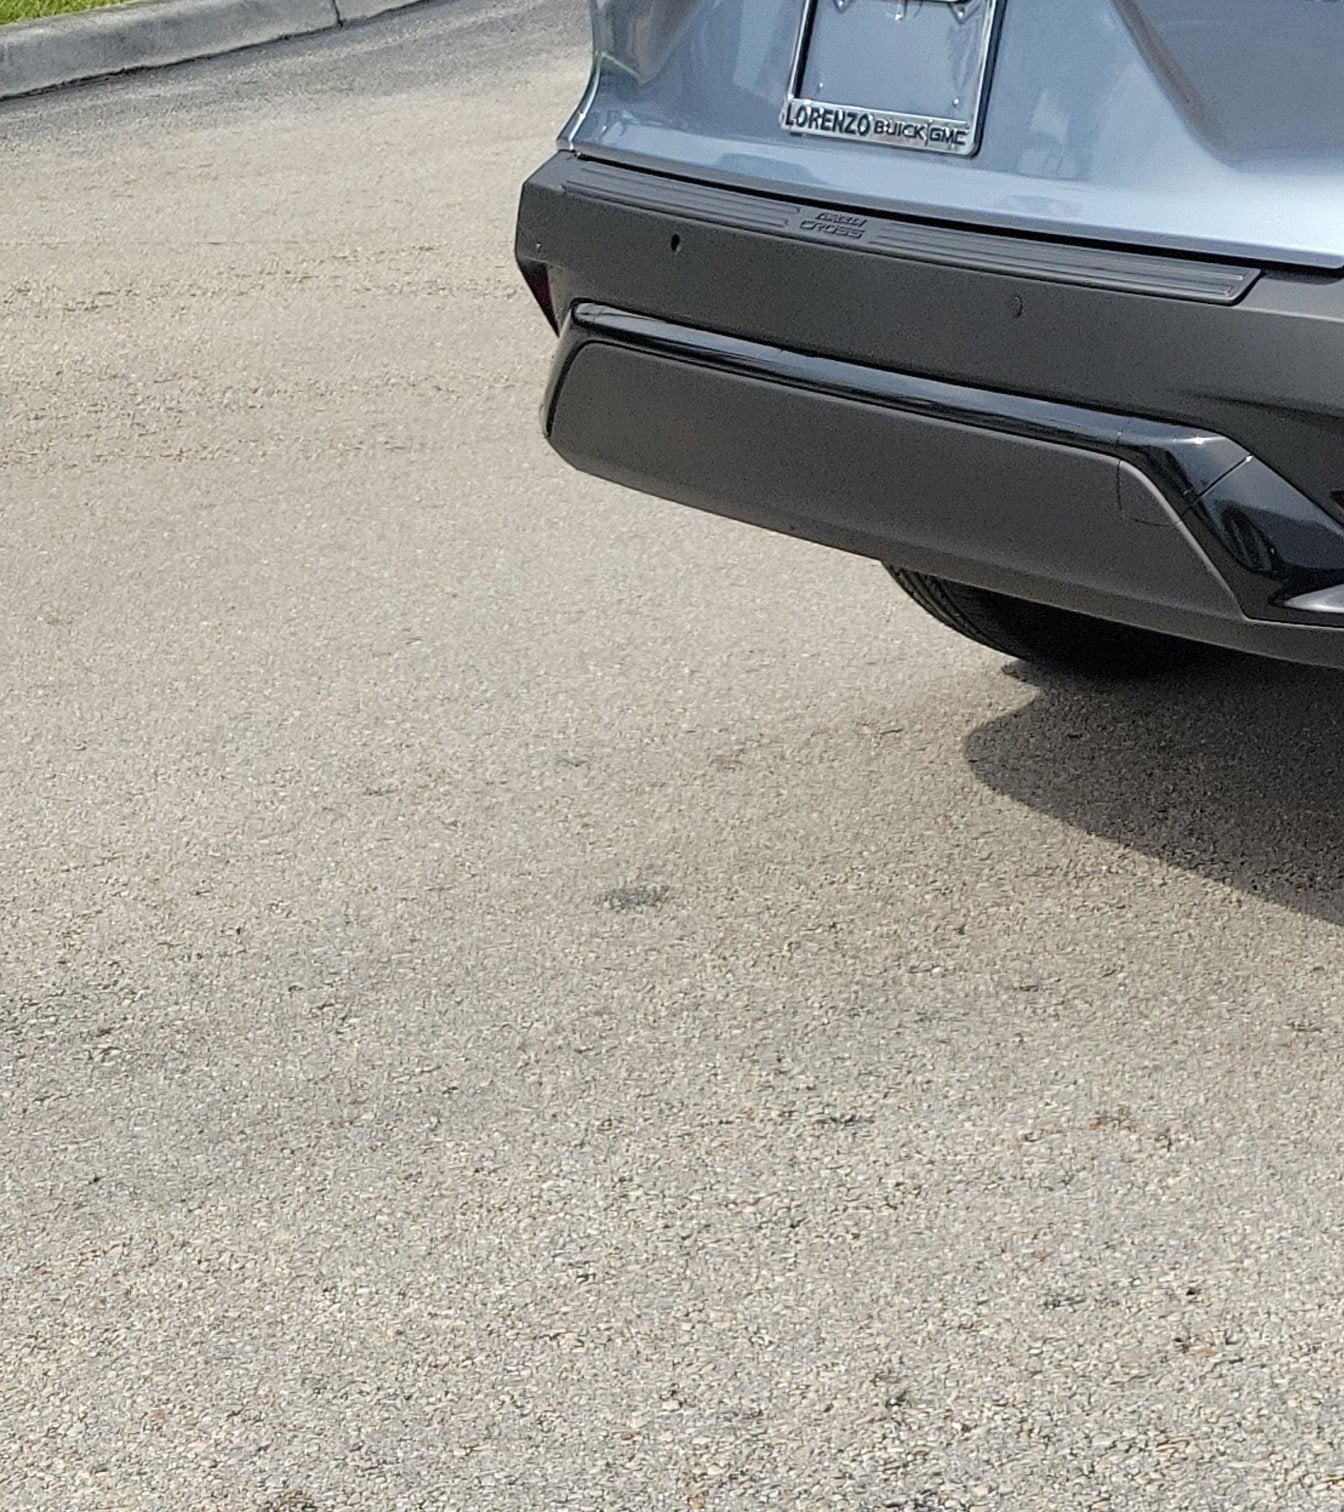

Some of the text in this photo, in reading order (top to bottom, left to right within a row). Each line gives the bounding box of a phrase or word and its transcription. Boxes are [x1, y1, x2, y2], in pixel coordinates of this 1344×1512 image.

[785, 102, 968, 146] LORENZO BUICK GMC
